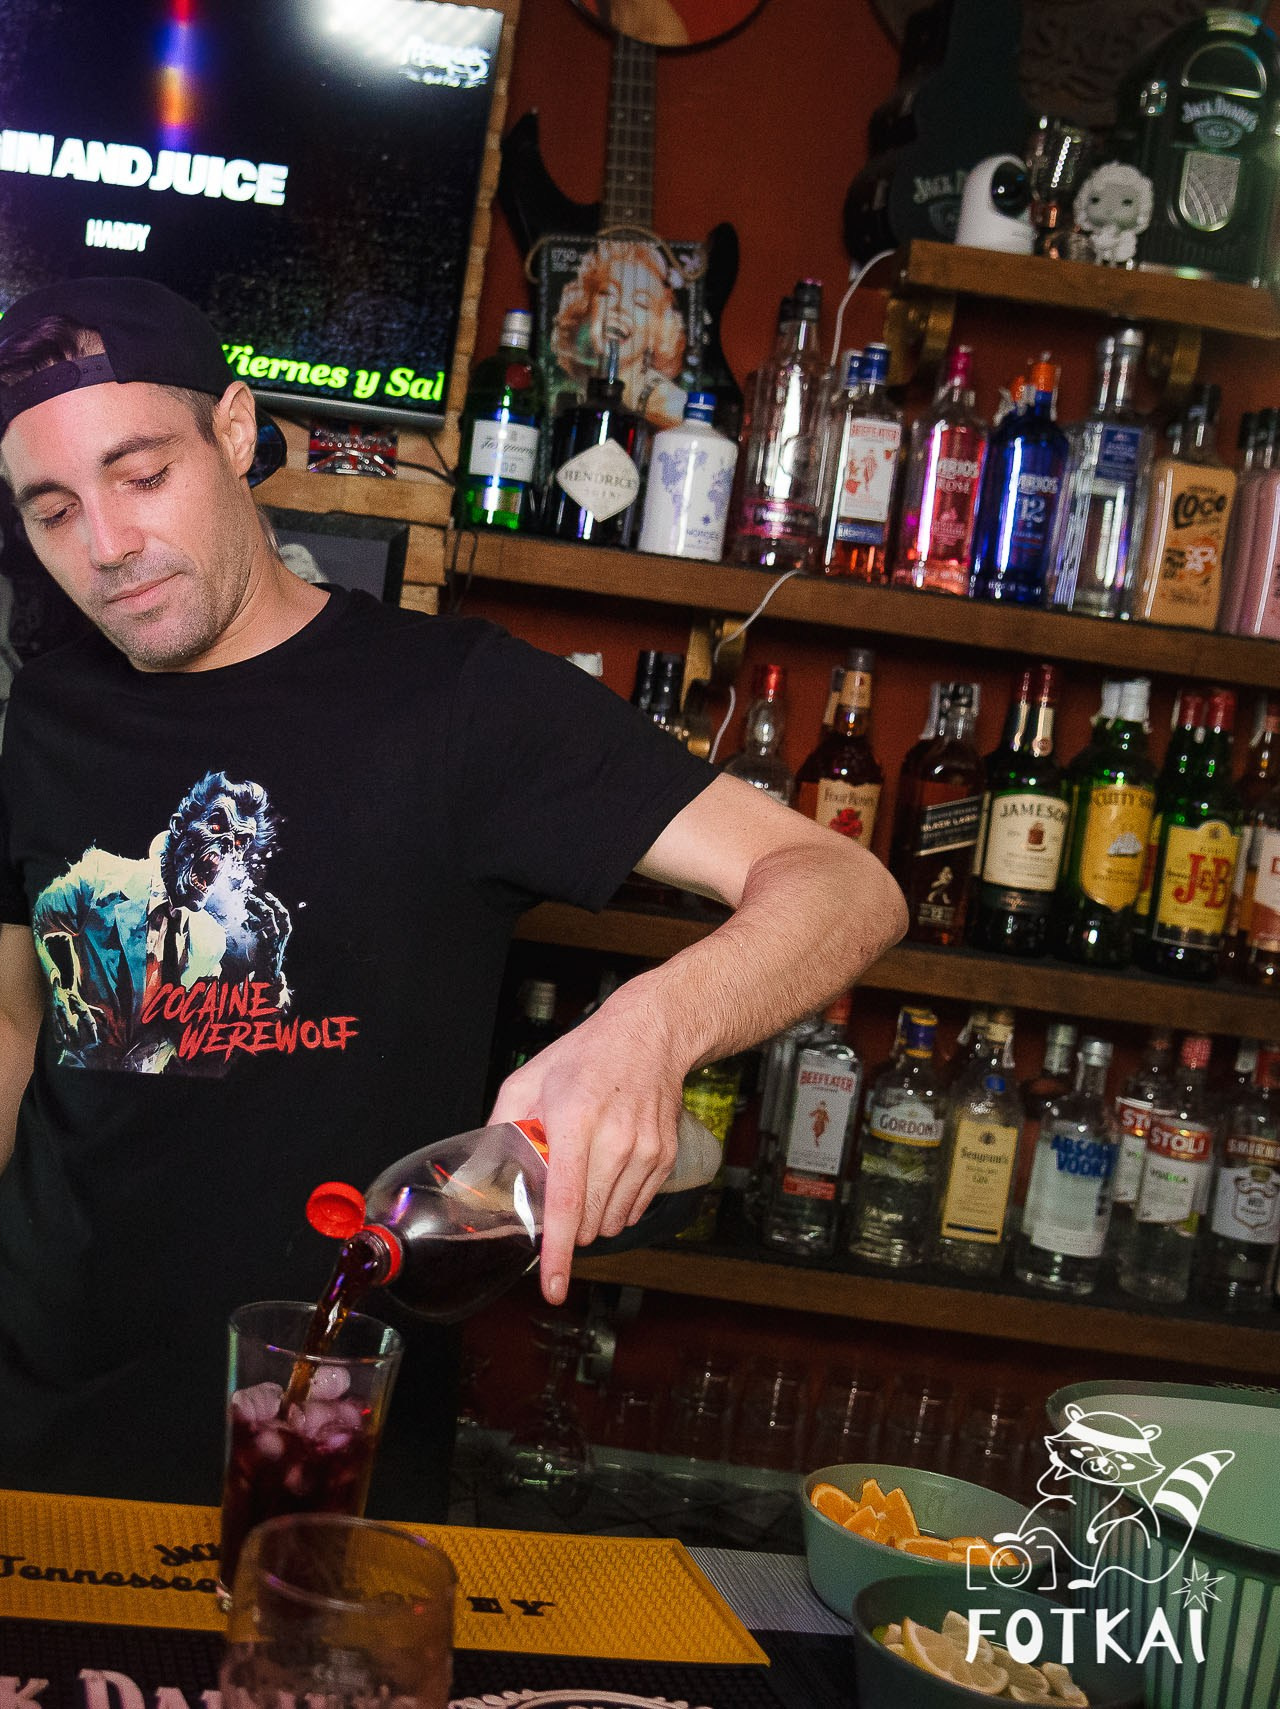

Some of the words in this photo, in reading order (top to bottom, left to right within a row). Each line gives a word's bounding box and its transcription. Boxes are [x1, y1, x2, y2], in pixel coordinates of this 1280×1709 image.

[52, 138, 153, 187] AND
[148, 150, 289, 206] JUICE
[85, 218, 151, 252] HARDY
[352, 369, 381, 399] y
[141, 976, 282, 1025] COCAINE
[178, 1016, 360, 1064] WEREWOLF
[799, 1070, 855, 1093] BEEFEATER
[1150, 1129, 1206, 1154] STOLI
